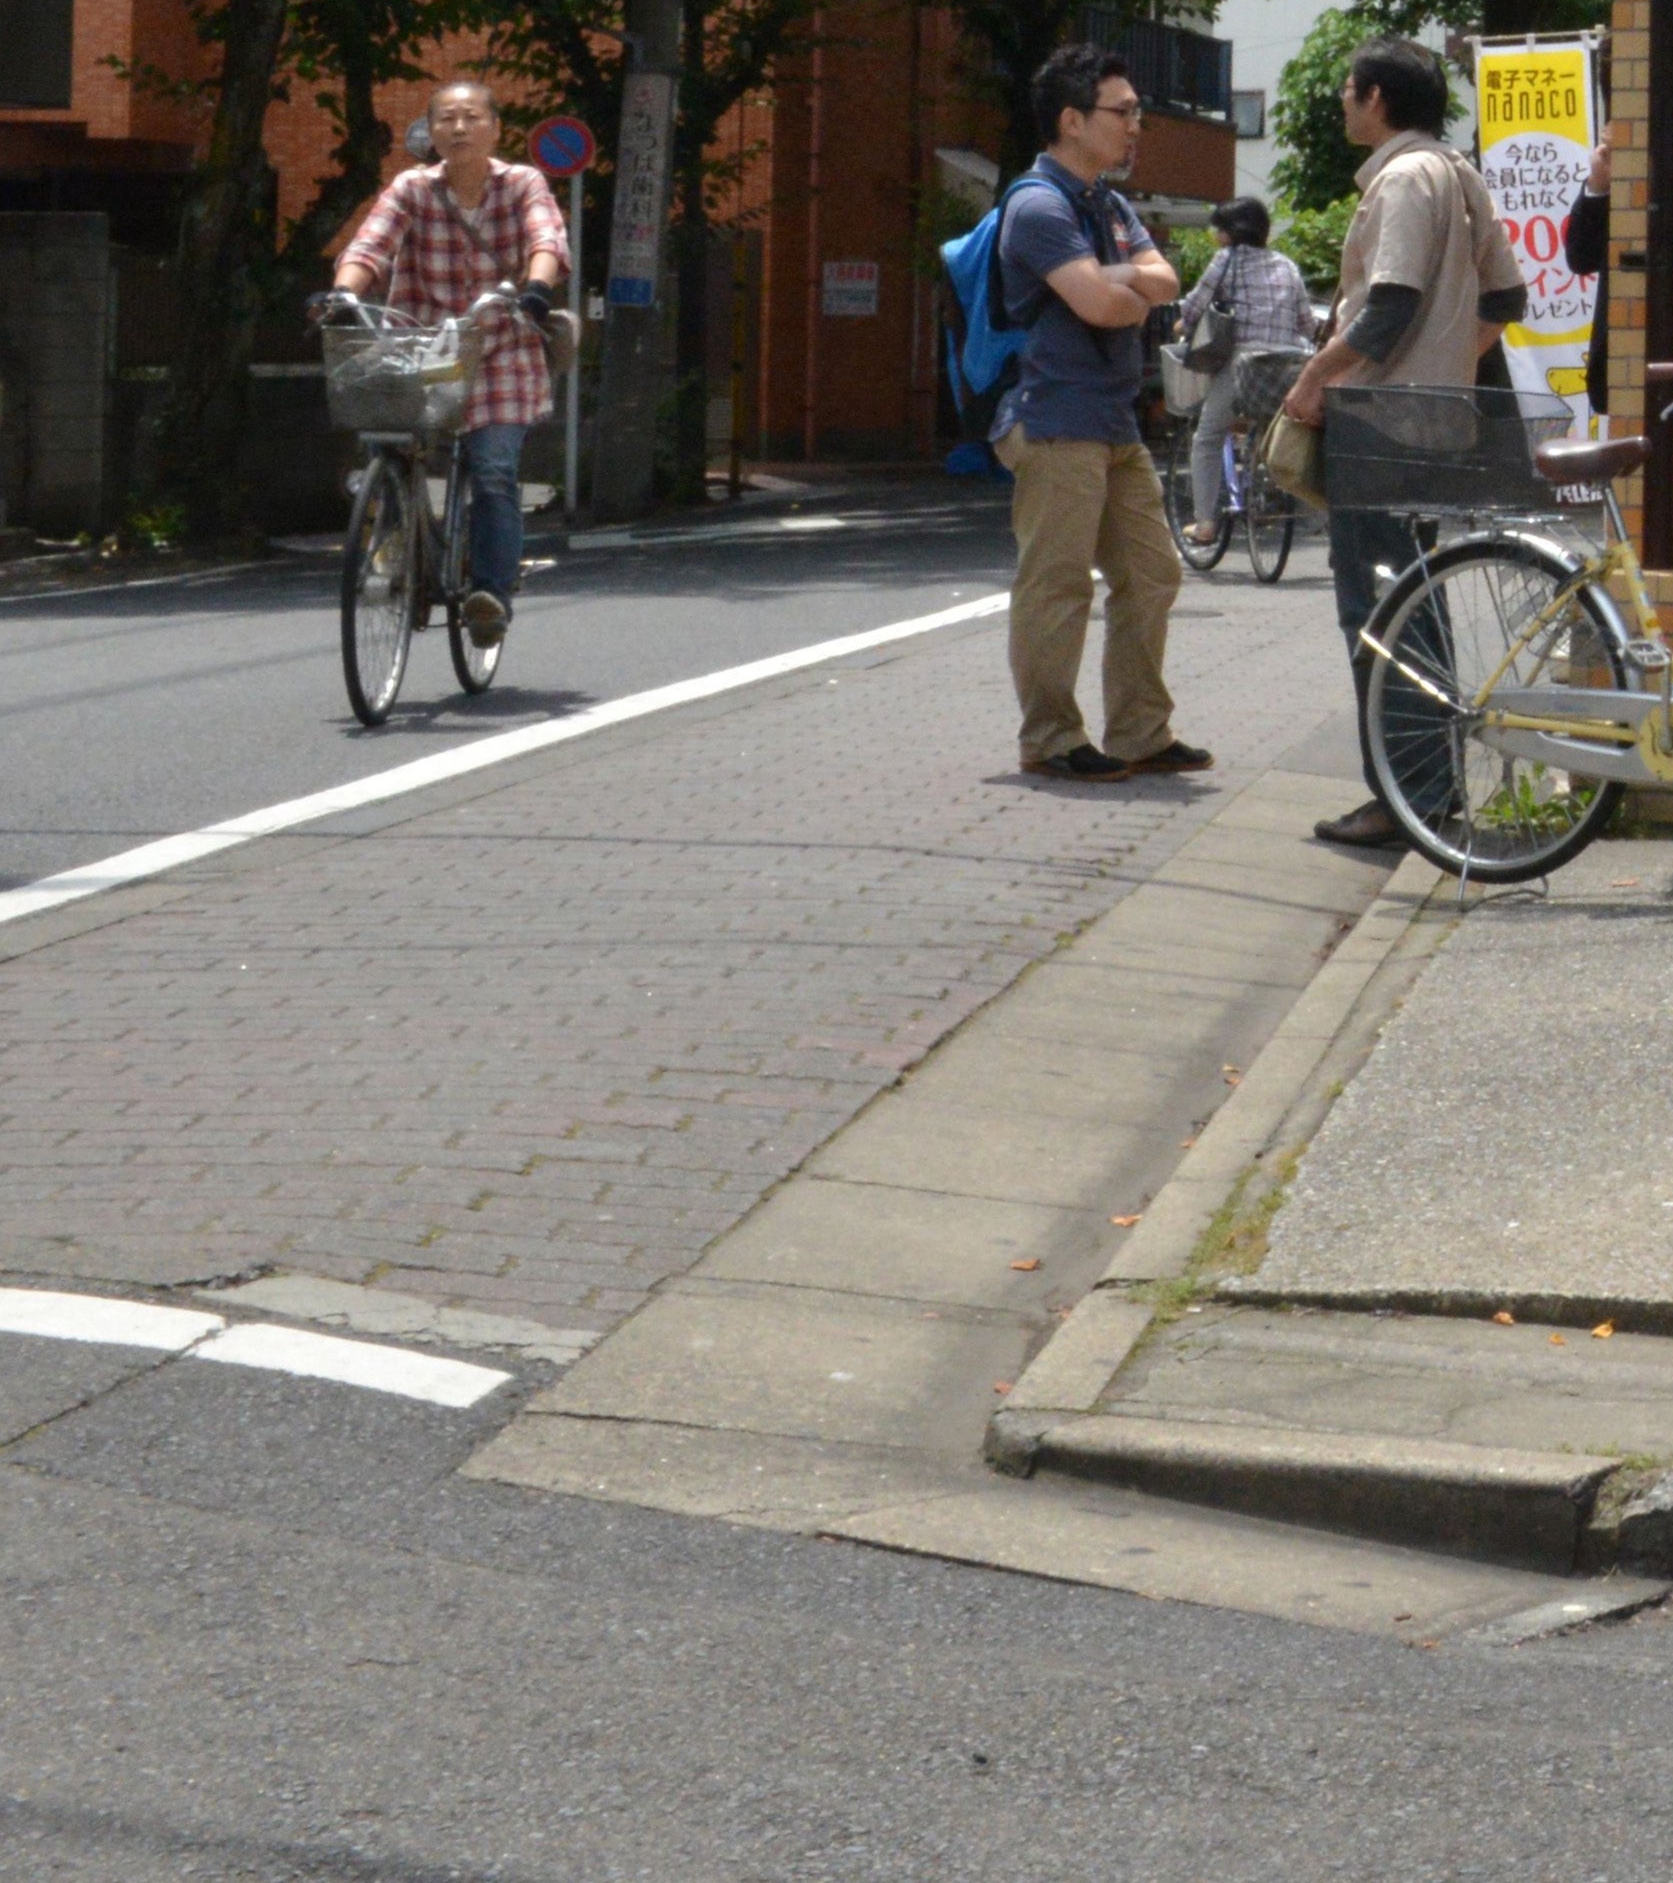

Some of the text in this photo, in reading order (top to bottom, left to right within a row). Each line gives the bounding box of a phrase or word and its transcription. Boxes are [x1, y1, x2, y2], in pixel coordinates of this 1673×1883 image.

[1486, 68, 1577, 91] 電子マネー
[1486, 88, 1578, 123] nanaco
[1504, 141, 1559, 166] 今なら
[1483, 162, 1588, 190] 会員になると
[1502, 187, 1570, 211] もれなく
[1526, 268, 1597, 298] イント
[1525, 298, 1593, 320] レゼント
